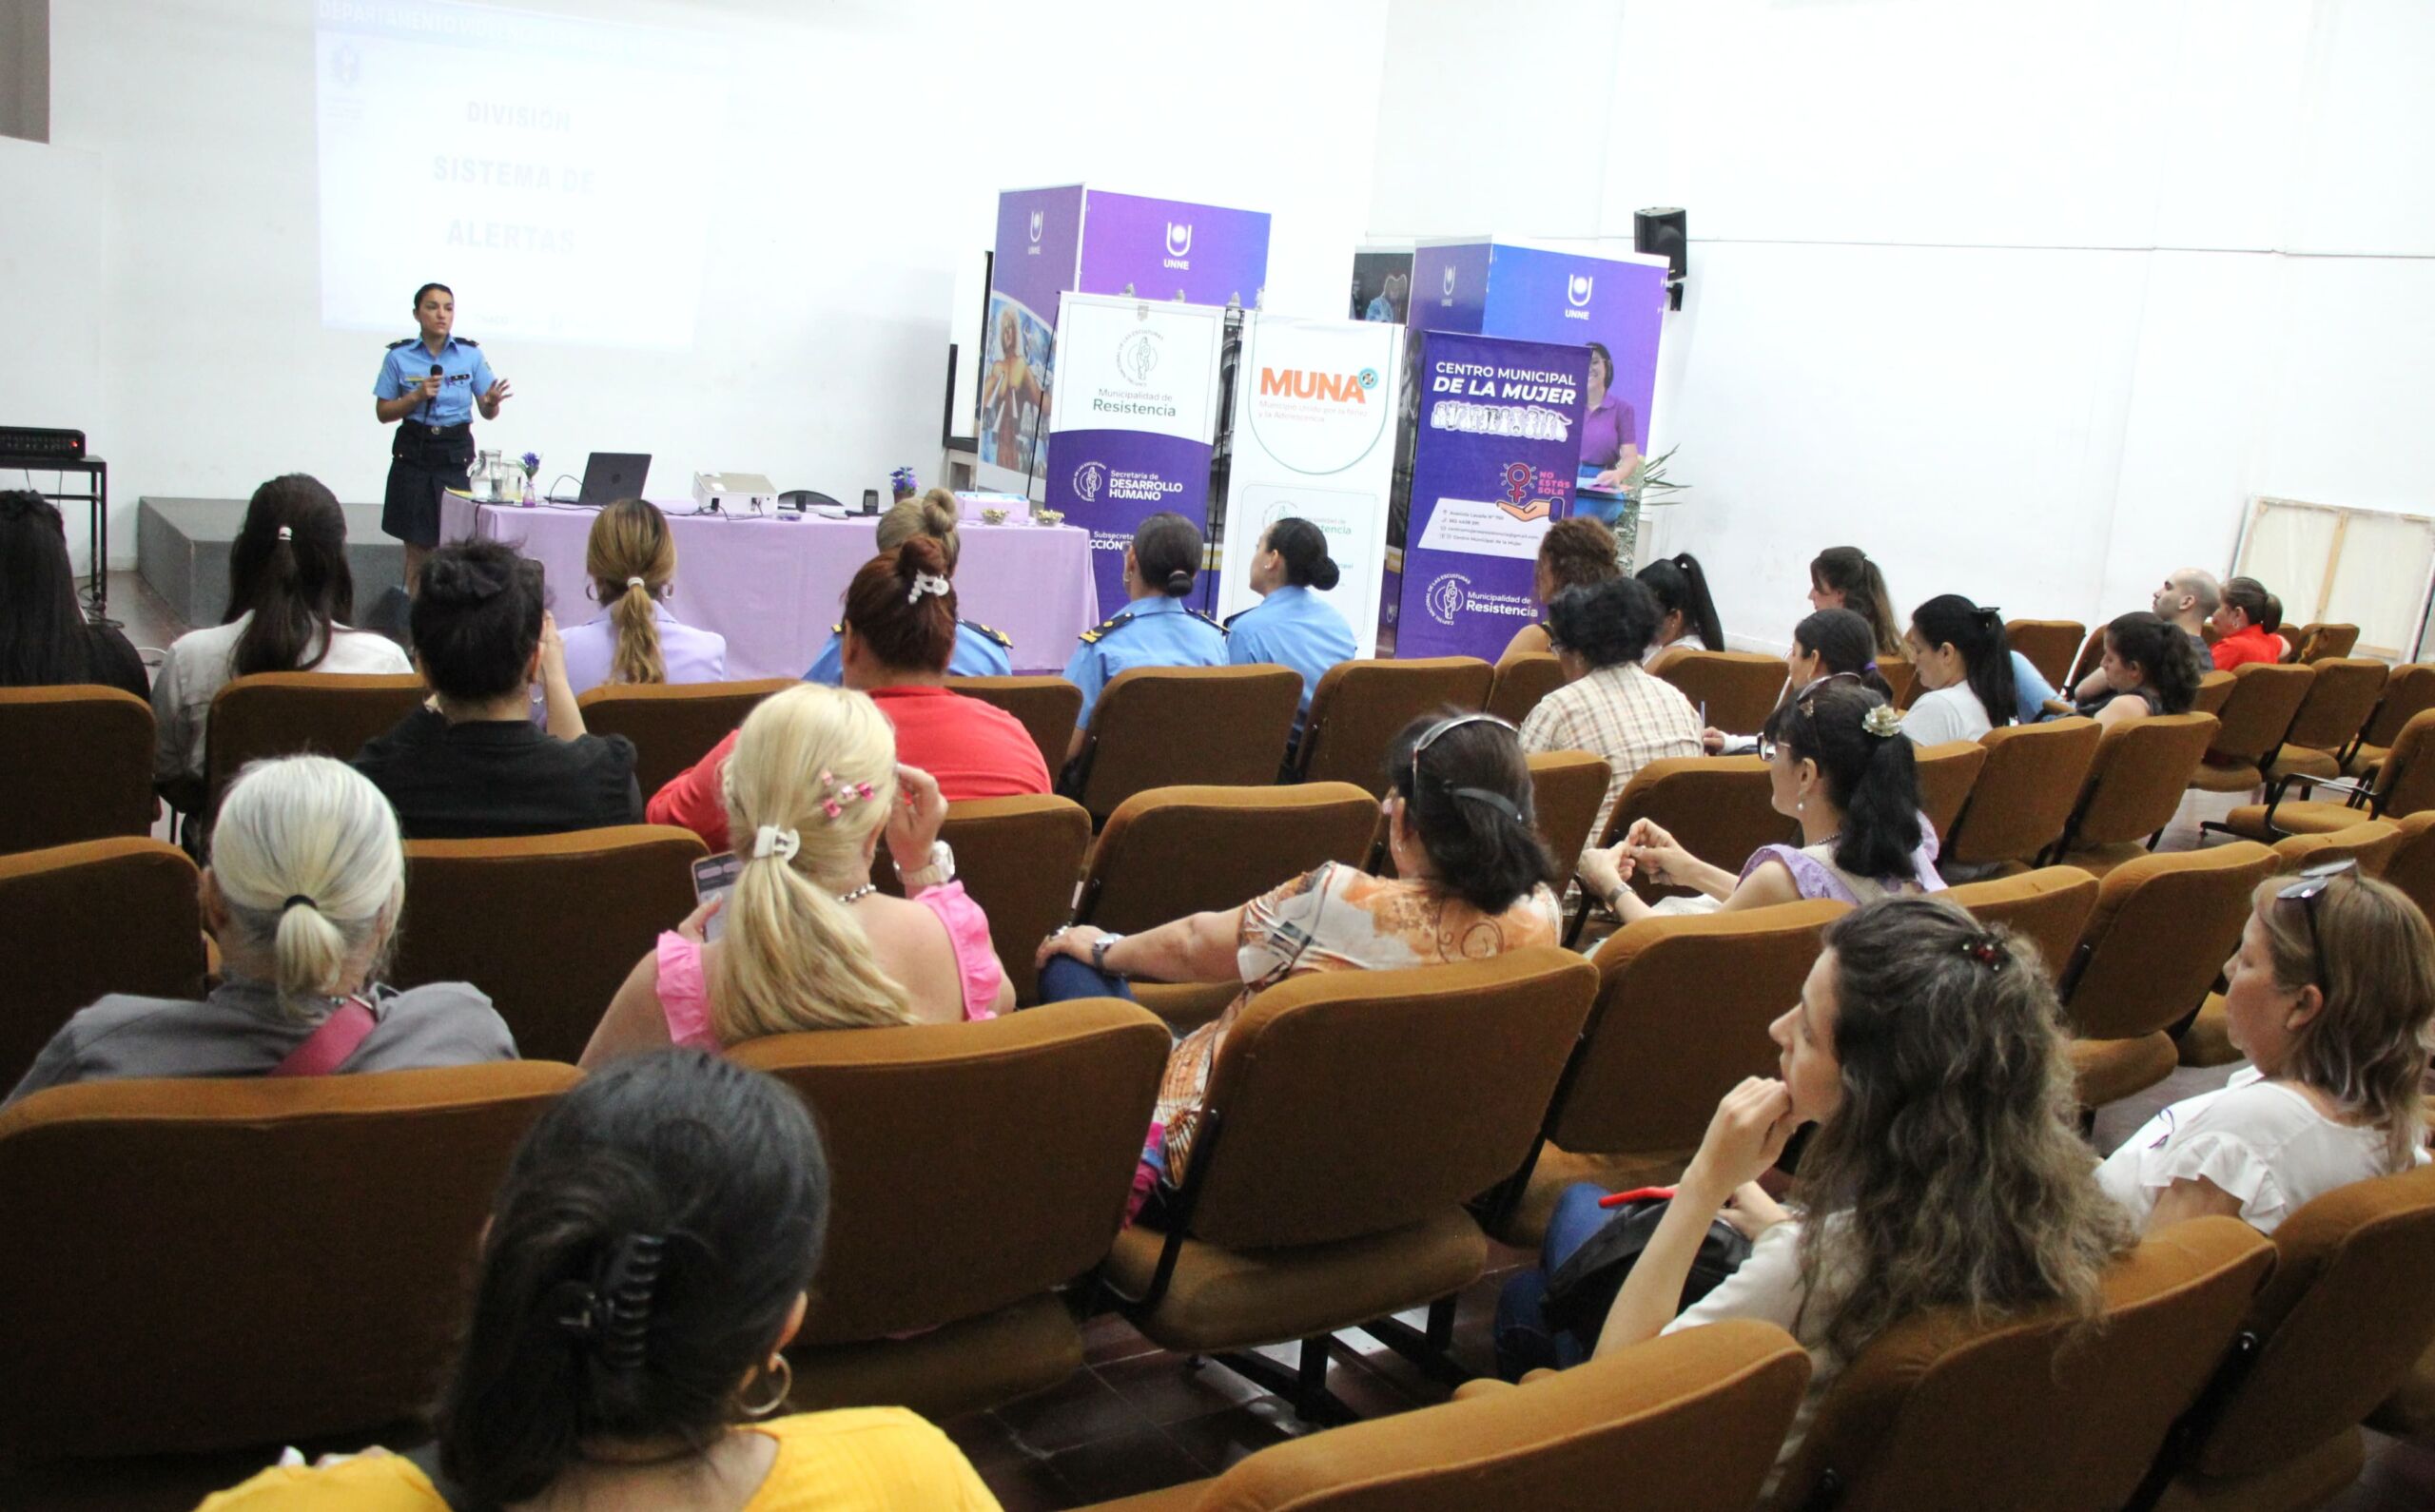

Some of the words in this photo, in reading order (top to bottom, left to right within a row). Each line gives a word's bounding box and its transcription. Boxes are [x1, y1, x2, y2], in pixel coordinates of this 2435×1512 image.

[319, 1, 457, 33] DEPARTAMENTO
[466, 99, 572, 133] DIVISIÓN
[433, 154, 552, 191] SISTEMA
[562, 167, 595, 196] DE
[446, 219, 576, 256] ALERTAS
[1164, 258, 1190, 271] UNNE
[1565, 309, 1590, 320] UNNE
[1435, 361, 1494, 378] CENTRO
[1497, 367, 1576, 386] MUNICIPAL
[1260, 367, 1366, 404] MUNA
[1432, 376, 1465, 394] DE
[1468, 378, 1496, 397] LA
[1501, 382, 1577, 405] MUJER
[1099, 388, 1159, 400] Municipalidad
[1161, 393, 1173, 402] de
[1093, 397, 1176, 417] Resistencia
[1539, 471, 1554, 479] NO
[1109, 477, 1183, 493] DESARROLLO
[1537, 486, 1565, 495] SOLA
[1109, 488, 1161, 501] HUMANO
[1094, 531, 1134, 540] Subsecreta
[1320, 524, 1352, 534] tencia
[1089, 538, 1123, 551] CCIÓN
[1467, 591, 1520, 604] Municipalidad
[1521, 596, 1531, 605] de
[1466, 599, 1538, 617] Resistencia
